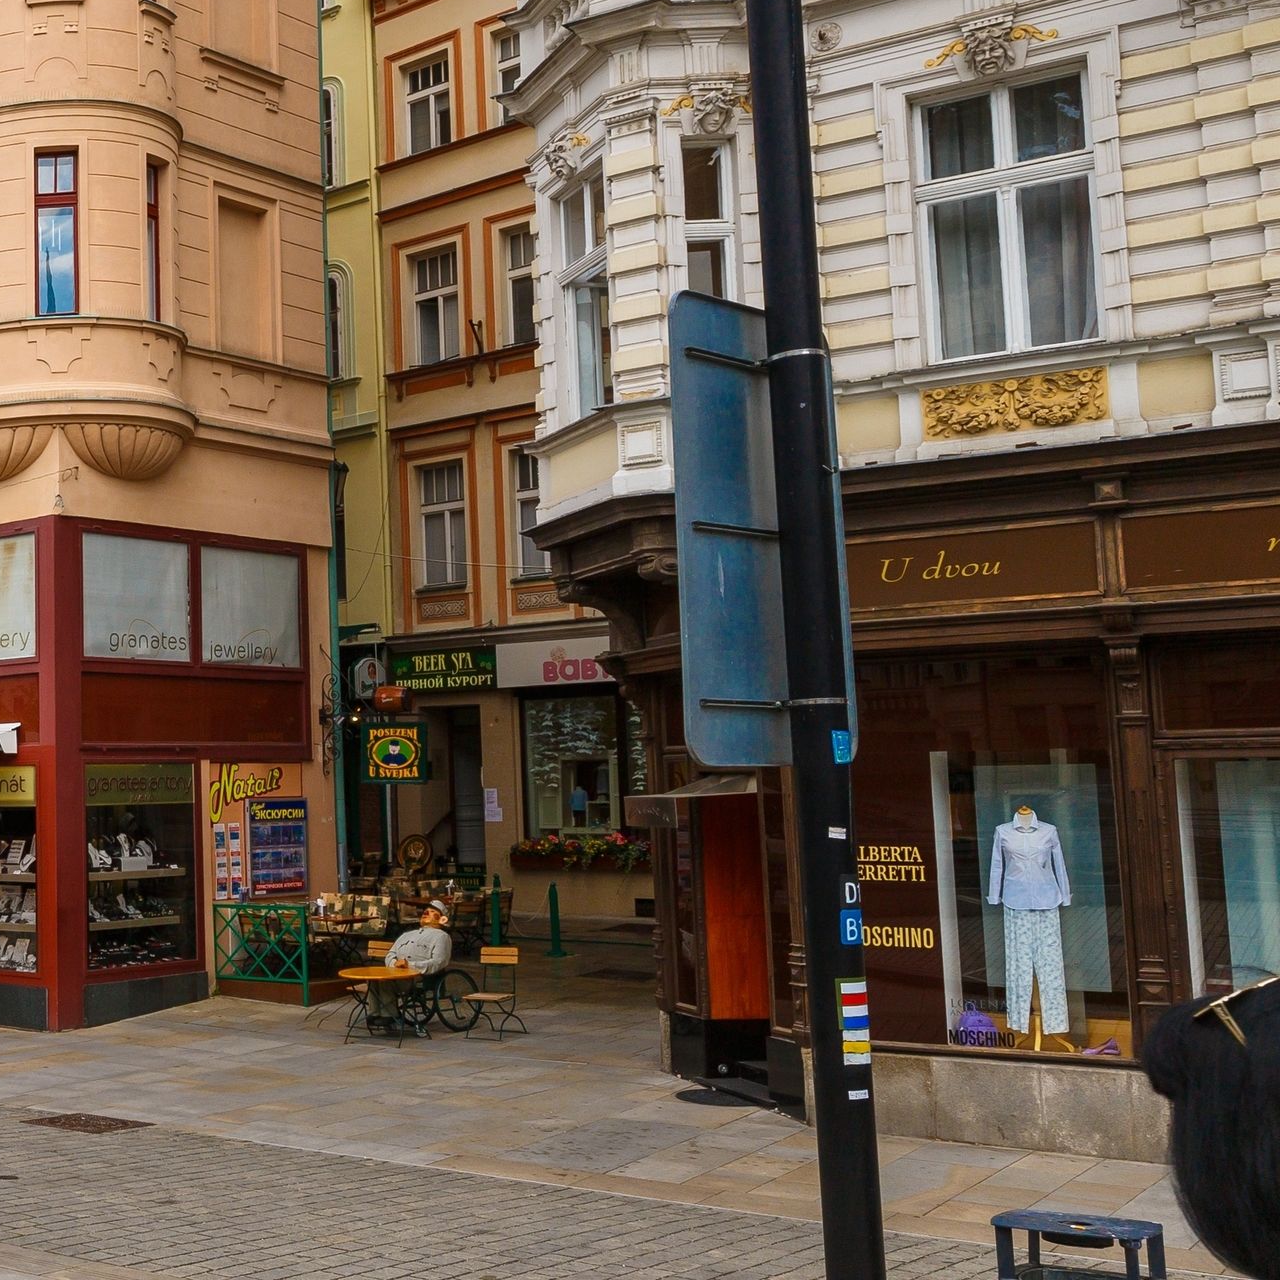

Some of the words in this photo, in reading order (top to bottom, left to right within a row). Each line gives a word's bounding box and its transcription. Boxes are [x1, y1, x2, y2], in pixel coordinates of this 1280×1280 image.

[880, 556, 913, 583] U
[921, 550, 1002, 581] dvou
[108, 630, 188, 652] granates
[208, 640, 279, 662] jewellery
[411, 653, 446, 672] BEER
[451, 651, 473, 674] SPA
[447, 674, 493, 688] КУРОРТ
[369, 726, 418, 741] POSEZENÍ
[368, 766, 376, 778] U
[209, 762, 282, 824] Natali
[254, 808, 305, 820] ЭКСКУРСИИ
[857, 845, 923, 863] LBERTA
[857, 864, 926, 883] ERRETTI
[862, 925, 935, 950] OSCHINO
[948, 1028, 1016, 1048] MOSCHINO
